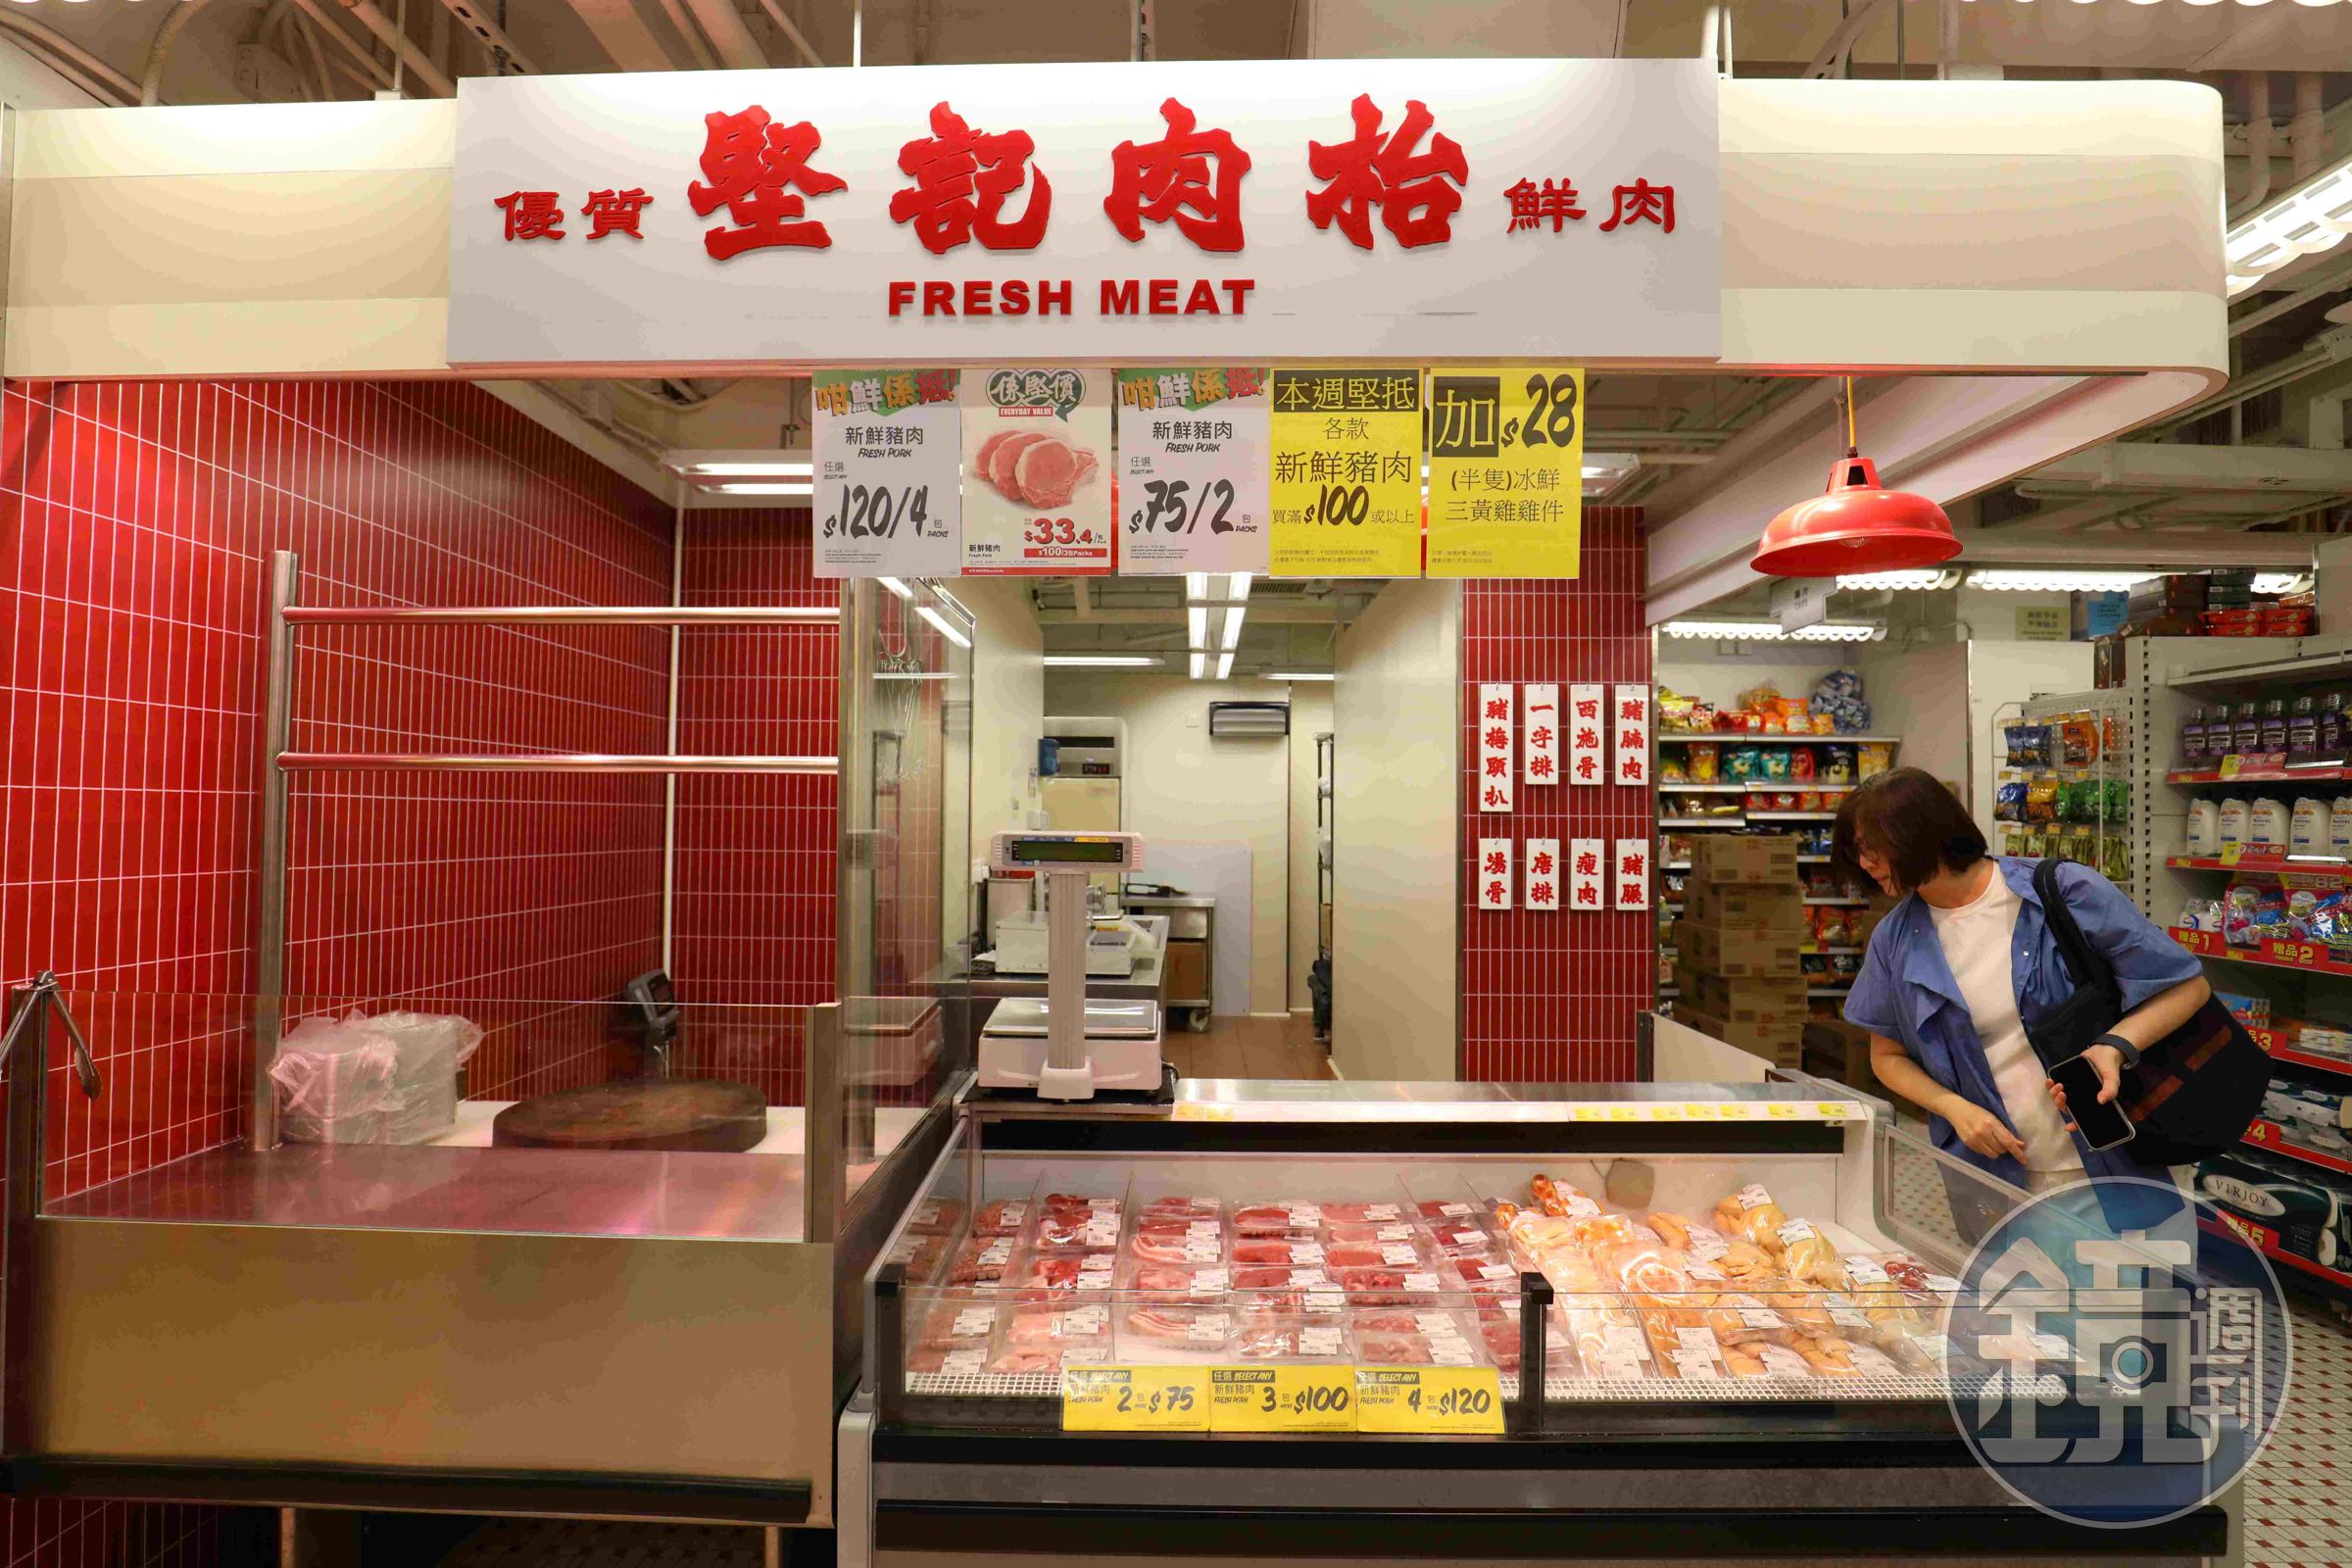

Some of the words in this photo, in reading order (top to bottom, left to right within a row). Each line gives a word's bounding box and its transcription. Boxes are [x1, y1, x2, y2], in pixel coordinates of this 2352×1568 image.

[494, 188, 654, 242] 優質
[687, 93, 1470, 261] 堅記肉枱
[1503, 177, 1676, 233] 鮮肉
[888, 280, 1072, 316] FRESH
[1100, 279, 1254, 315] MEAT
[1276, 376, 1415, 411] 本週堅抵
[1436, 389, 1495, 448] 加
[1500, 373, 1577, 449] $28
[846, 426, 923, 445] 新鮮豬肉
[1152, 420, 1233, 440] 新鮮豬肉
[1323, 417, 1369, 440] 各款
[858, 448, 886, 458] FRESH
[887, 448, 912, 458] PORK
[1165, 442, 1194, 453] FRESH
[1195, 442, 1220, 453] PORK
[823, 462, 844, 472] 任選
[1130, 457, 1151, 467] 任選
[1275, 451, 1411, 484] 新鮮豬肉
[1451, 467, 1560, 492] (半隻)冰鮮
[823, 484, 928, 539] $120/4
[934, 519, 942, 528] 包
[1129, 478, 1235, 535] $75/2
[1446, 499, 1564, 522] 三黃雞雞件
[1024, 517, 1093, 545] $33.4
[969, 544, 1001, 553] 新鮮豬肉
[1530, 704, 1554, 778] 一字排
[1576, 699, 1599, 780] 西施骨
[1620, 699, 1644, 780] 豬腩肉
[1485, 852, 1507, 905] 湯骨
[1531, 852, 1554, 906] 唐排
[1577, 852, 1599, 906] 瘦肉
[2299, 946, 2314, 964] 2
[2259, 1033, 2272, 1052] 3
[2252, 1123, 2266, 1142] 4
[2216, 1180, 2269, 1207] VIRJOY
[2251, 1227, 2265, 1247] 5
[1214, 1372, 1232, 1381] 任選
[1234, 1372, 1257, 1381] SELECT
[1378, 1373, 1401, 1382] SELECT
[1117, 1386, 1132, 1412] 2
[1149, 1386, 1196, 1413] $75
[1214, 1384, 1254, 1395] 新鮮豬肉
[1261, 1387, 1276, 1412] 3
[1294, 1386, 1349, 1414] $100
[1360, 1386, 1400, 1396] 新鮮豬肉
[1408, 1388, 1421, 1413] 4
[1439, 1388, 1491, 1415] $120
